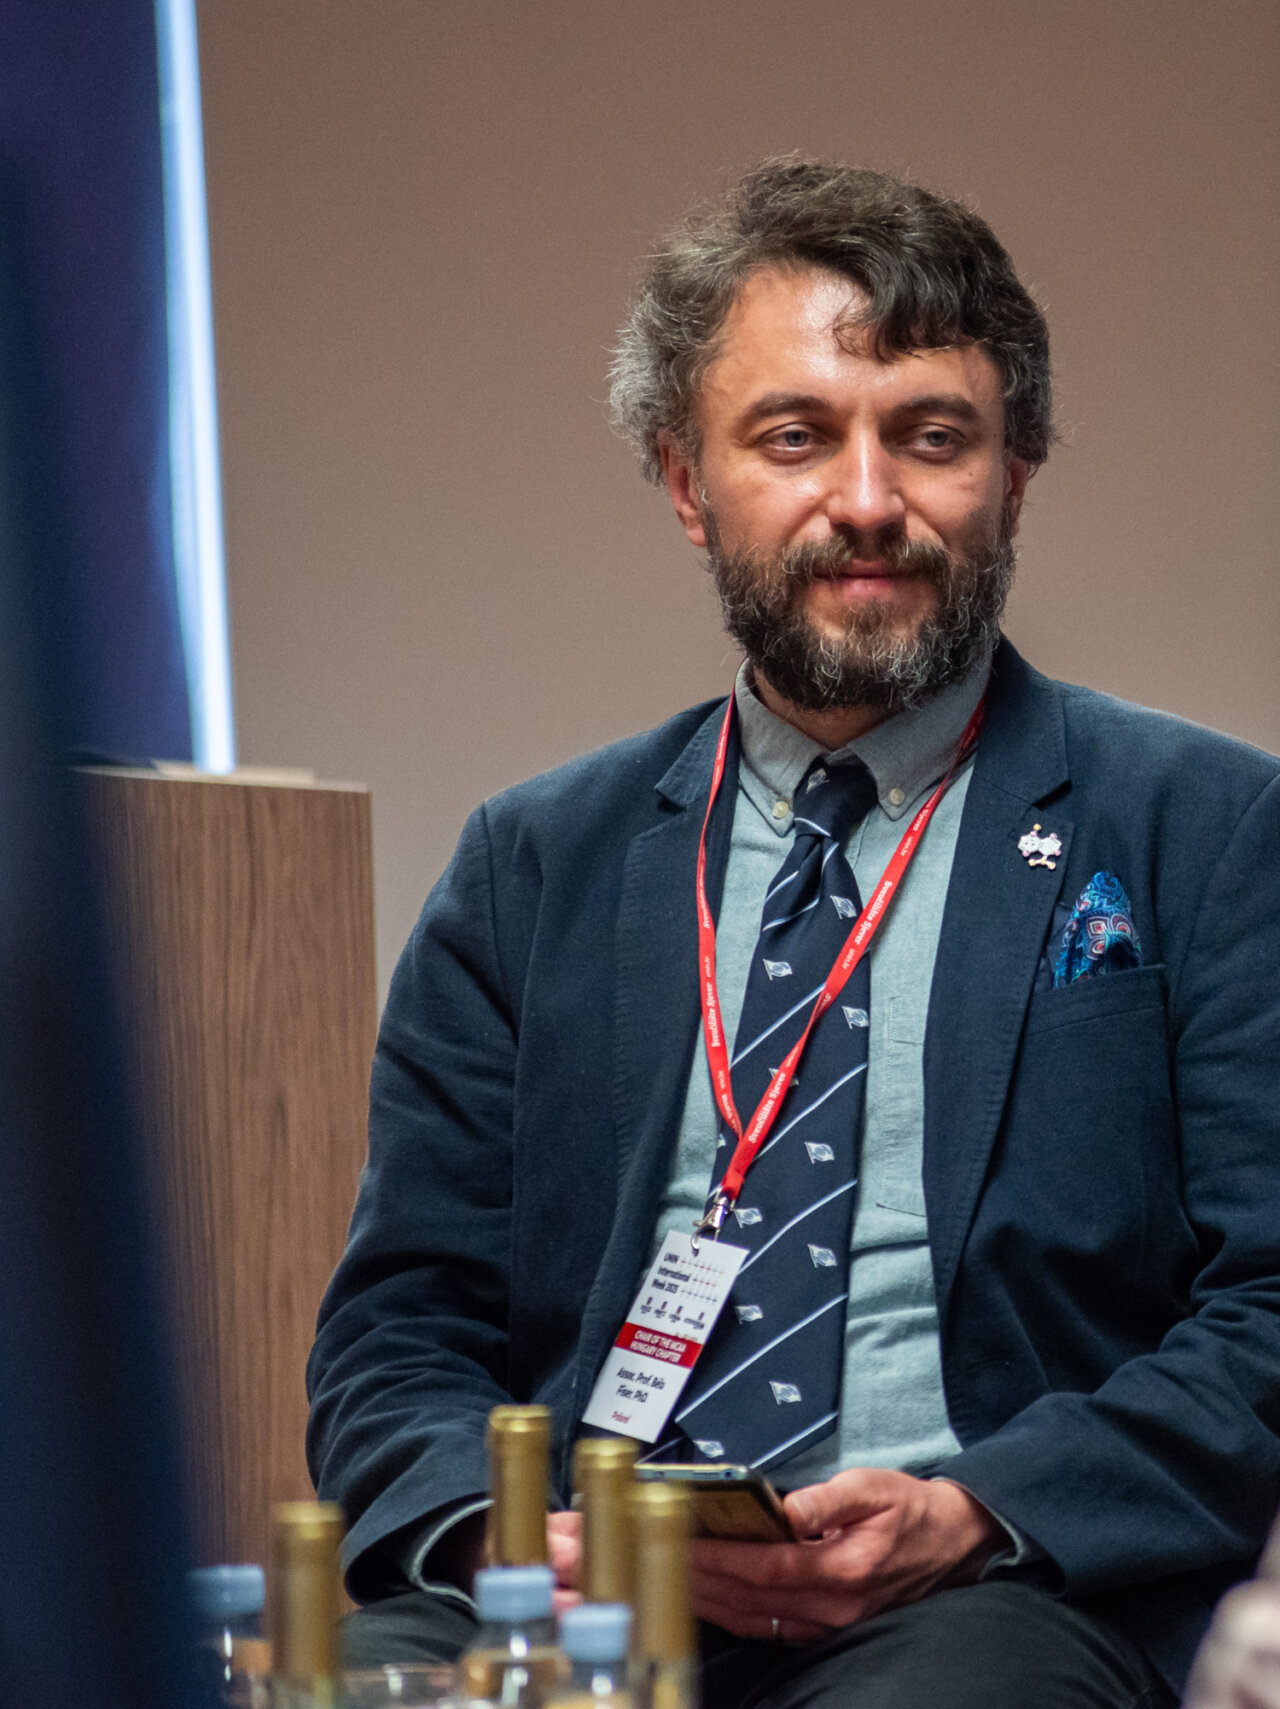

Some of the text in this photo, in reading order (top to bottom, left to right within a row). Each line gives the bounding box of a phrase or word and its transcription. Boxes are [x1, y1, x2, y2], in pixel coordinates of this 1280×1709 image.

[854, 918, 872, 946] Sjever
[706, 982, 717, 1007] Sjever
[748, 1099, 775, 1144] Sveučilište
[768, 1072, 786, 1099] Sjever
